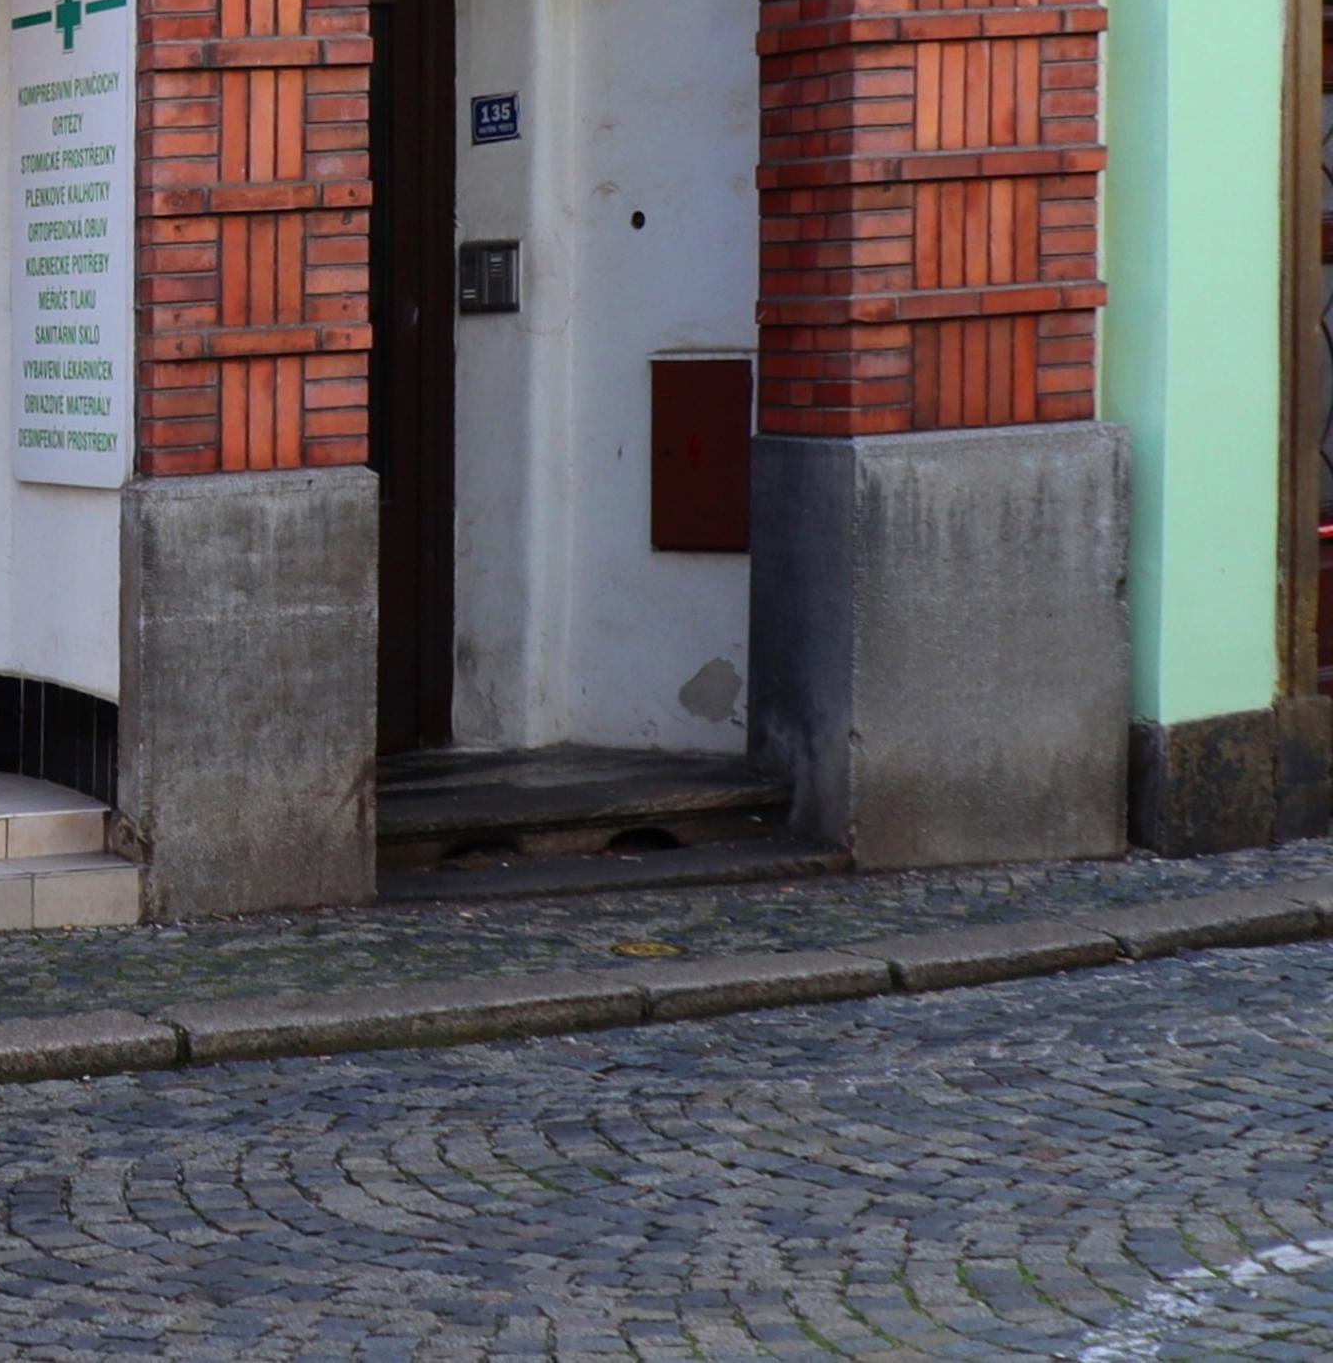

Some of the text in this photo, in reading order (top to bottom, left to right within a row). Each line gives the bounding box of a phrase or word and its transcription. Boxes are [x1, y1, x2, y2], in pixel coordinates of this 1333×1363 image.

[481, 103, 511, 123] 135
[52, 111, 83, 136] ORTÉZY
[70, 290, 96, 309] TLAKU
